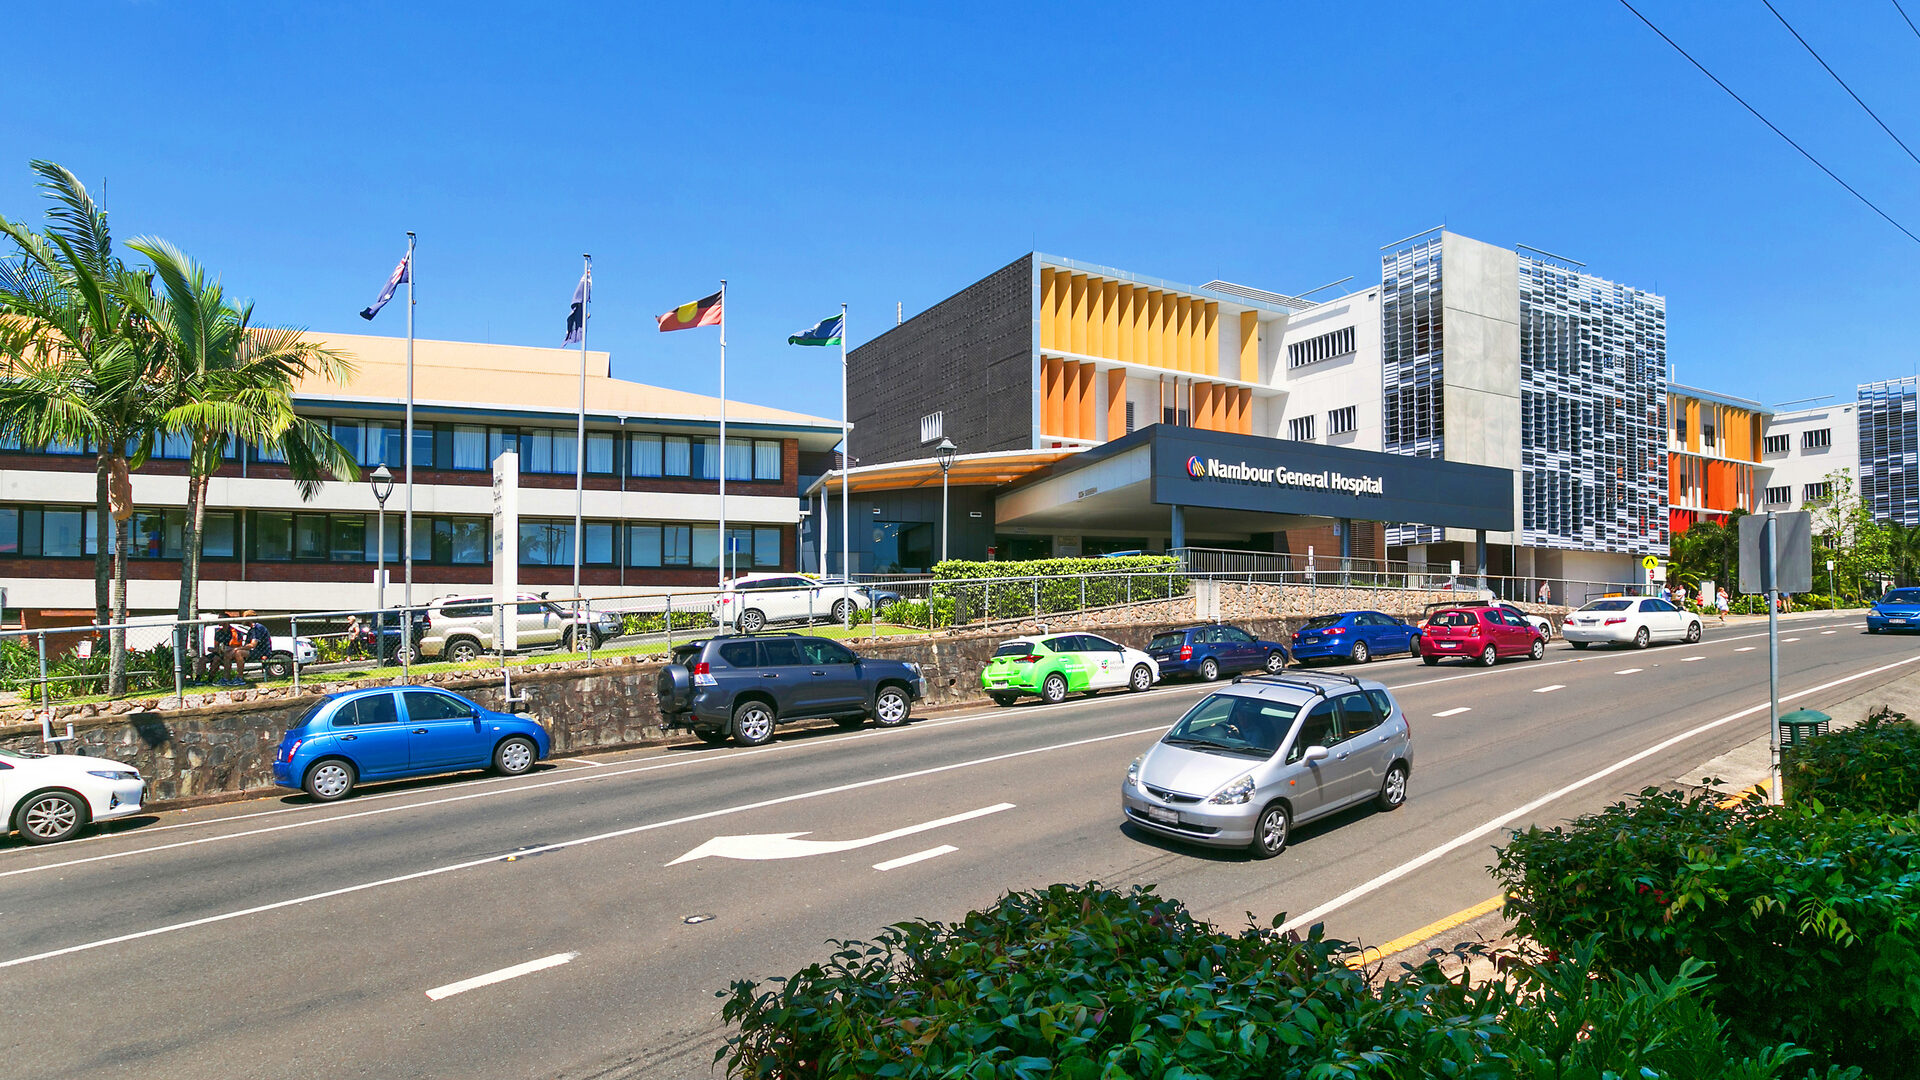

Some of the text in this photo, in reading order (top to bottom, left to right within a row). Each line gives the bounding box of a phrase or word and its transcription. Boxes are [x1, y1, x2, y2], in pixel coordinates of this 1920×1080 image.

[1207, 458, 1383, 496] Nambour General Hospital
